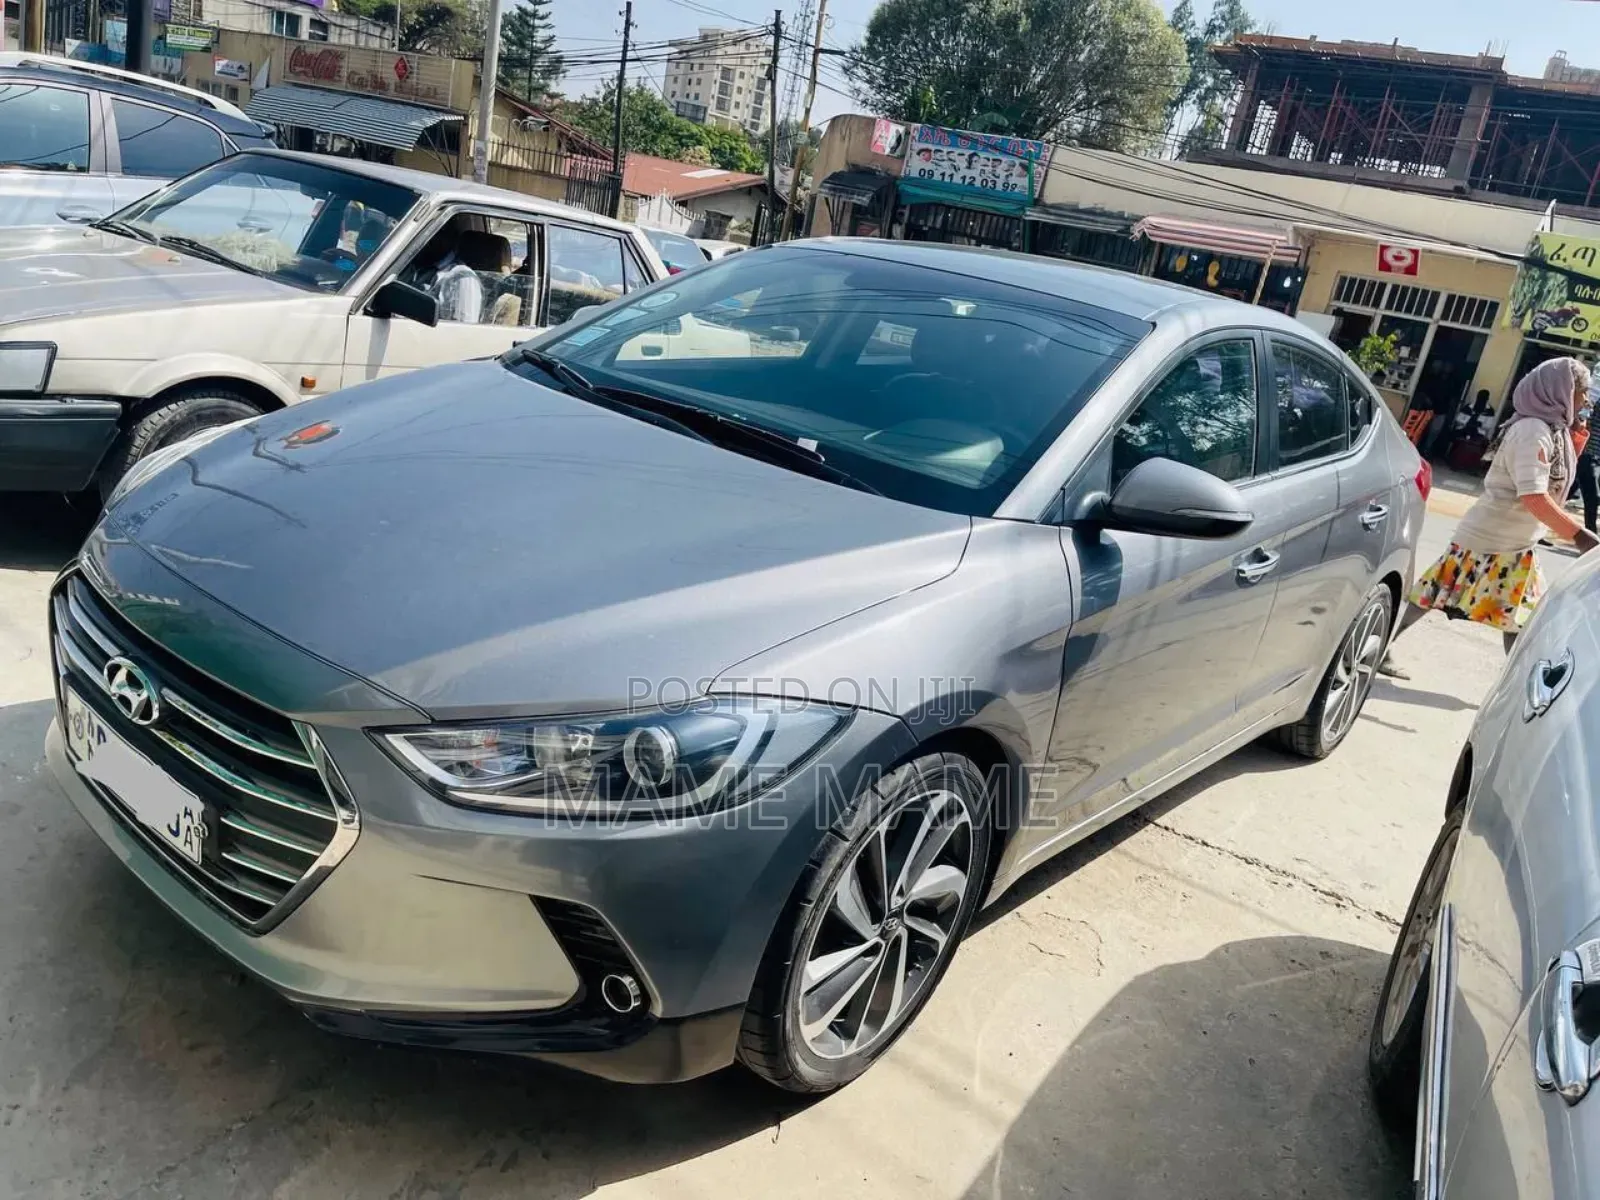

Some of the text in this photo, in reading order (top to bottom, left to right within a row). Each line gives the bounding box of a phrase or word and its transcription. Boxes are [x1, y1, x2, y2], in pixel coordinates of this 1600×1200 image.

[918, 168, 1018, 192] 09 11 12 03 99
